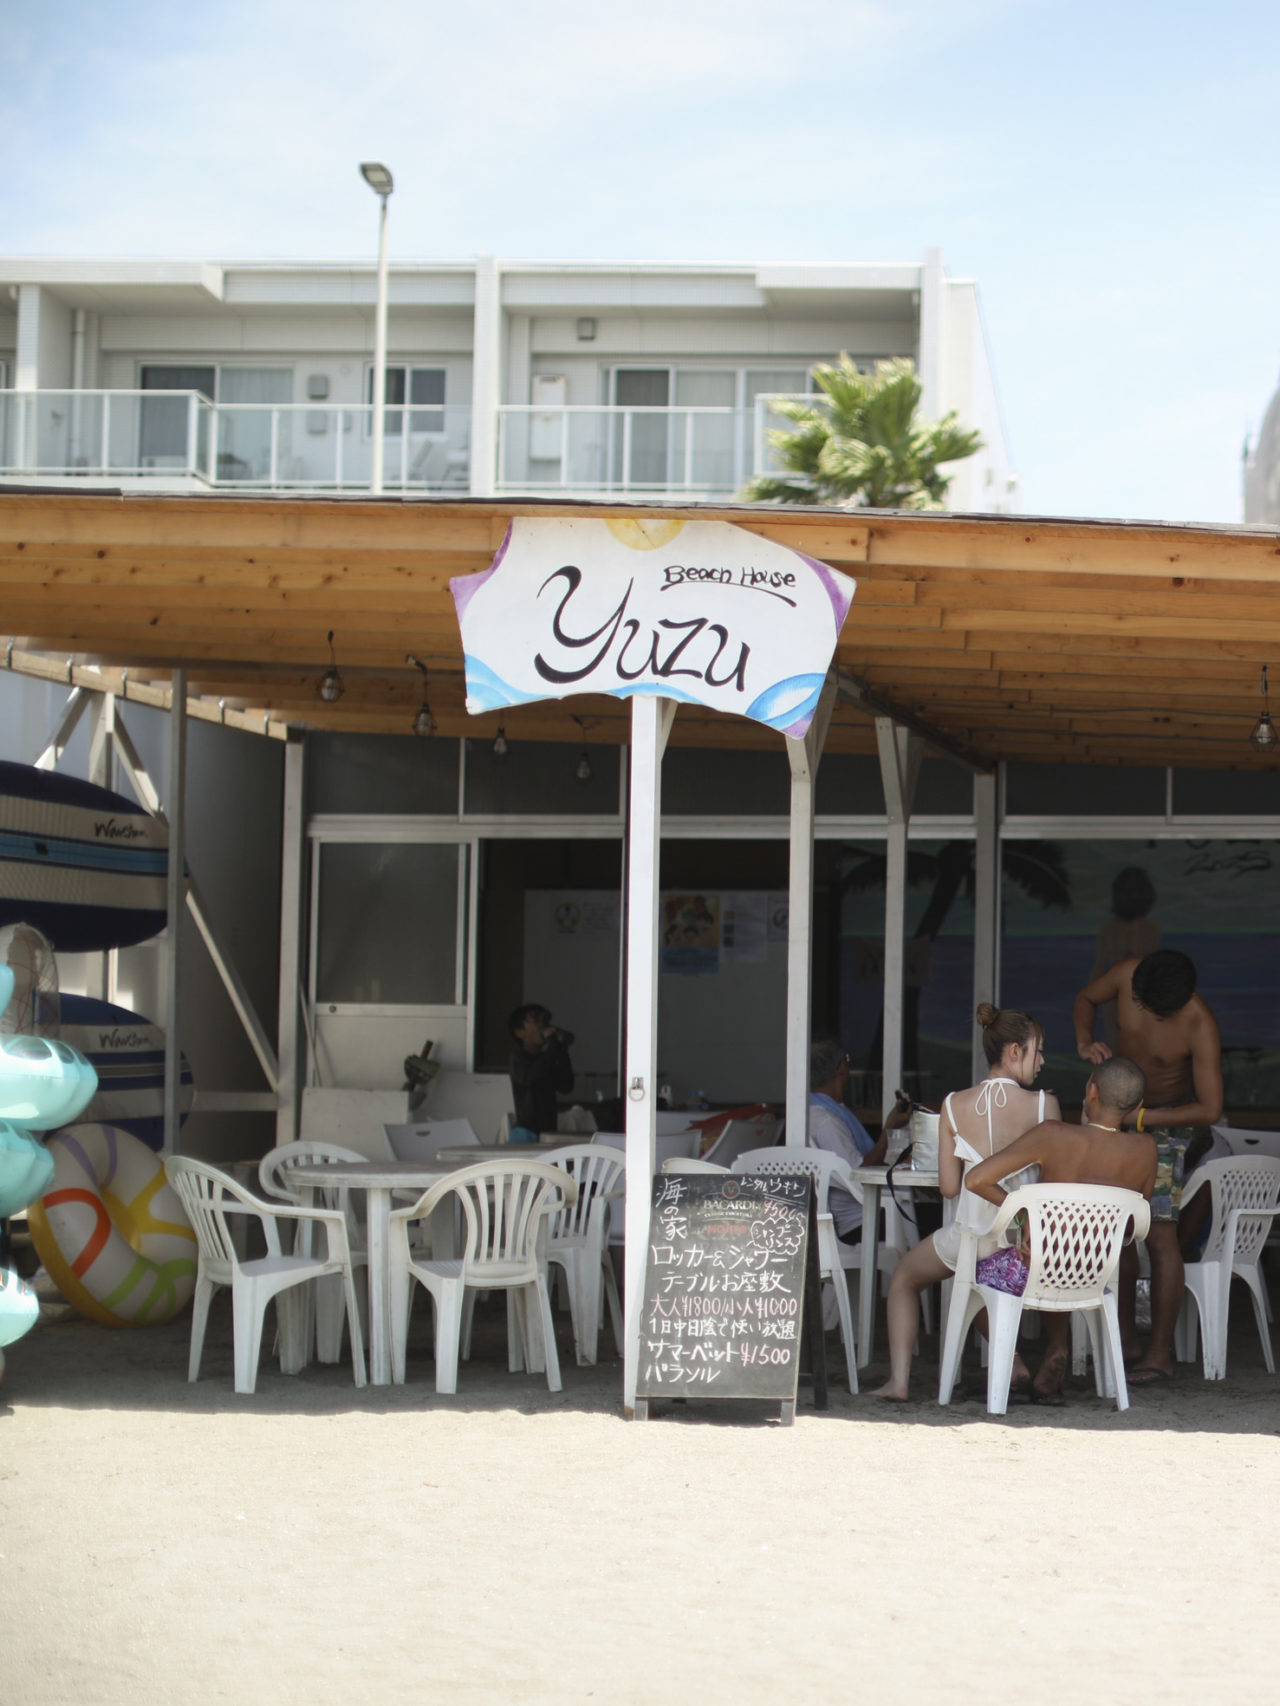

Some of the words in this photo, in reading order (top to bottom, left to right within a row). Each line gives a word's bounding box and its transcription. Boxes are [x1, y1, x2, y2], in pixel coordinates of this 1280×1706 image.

[663, 565, 733, 586] Beach
[740, 566, 797, 589] House
[655, 1178, 687, 1241] 海の家
[704, 1200, 756, 1210] BACARDI
[645, 1363, 721, 1384] パラソル
